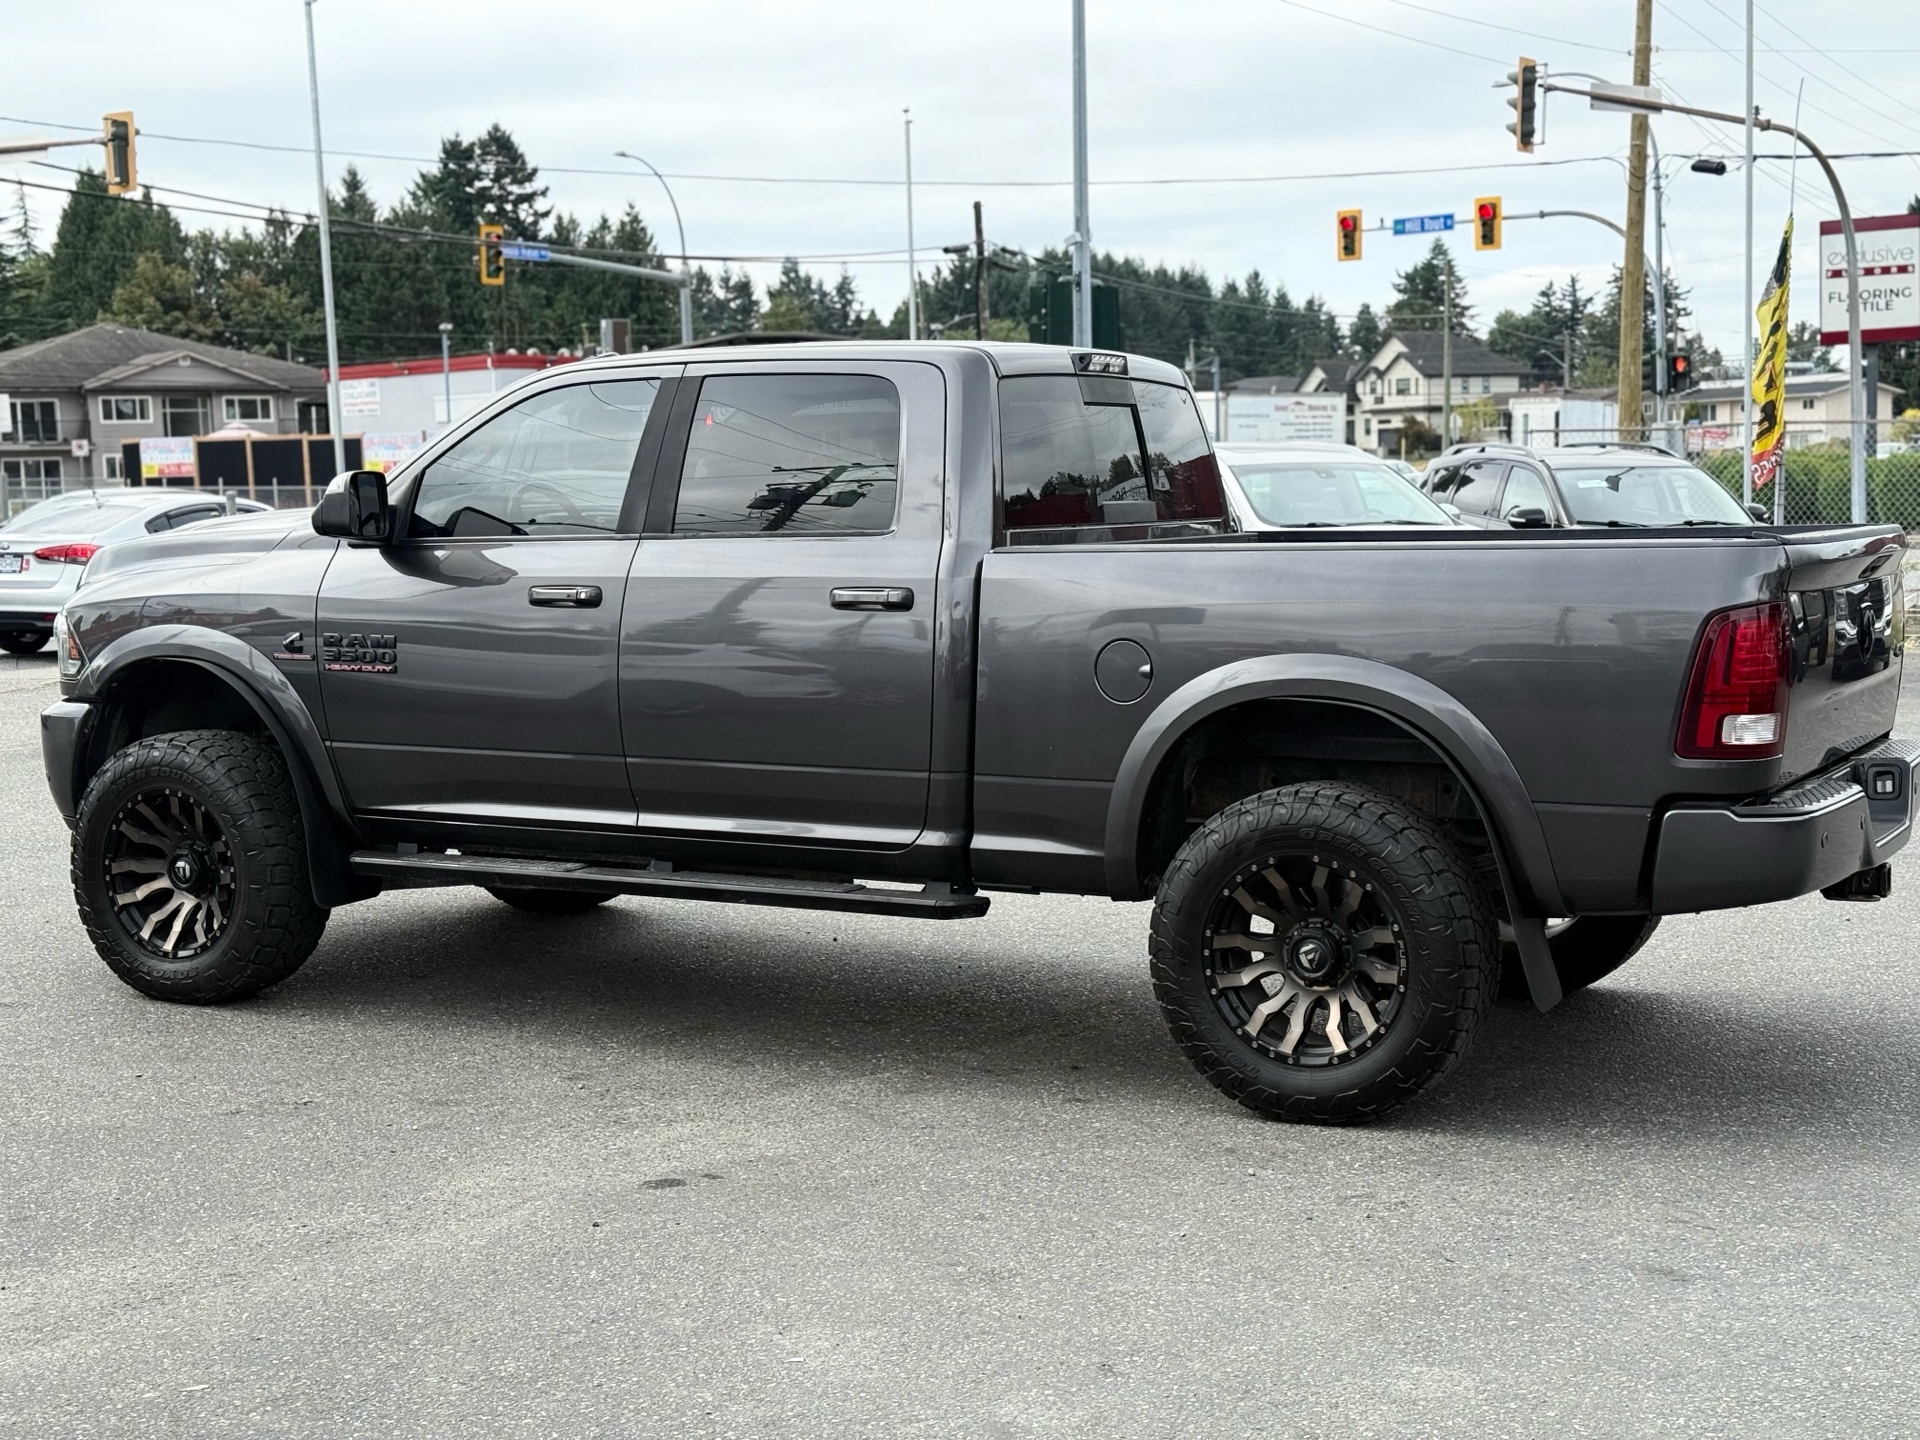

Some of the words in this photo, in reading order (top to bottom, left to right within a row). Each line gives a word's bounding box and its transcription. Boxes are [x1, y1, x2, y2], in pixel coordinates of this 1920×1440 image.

[1405, 217, 1421, 233] Hill
[1424, 216, 1445, 230] Tout
[1827, 240, 1914, 266] exlusive
[1829, 287, 1912, 303] FLORING
[1861, 300, 1894, 312] TILE
[323, 633, 397, 649] RAM
[324, 648, 397, 664] 3500
[1299, 828, 1368, 858] OPEN
[1397, 940, 1407, 977] FUEL
[152, 966, 198, 980] TOYO
[1201, 1025, 1260, 1079] TOYO
